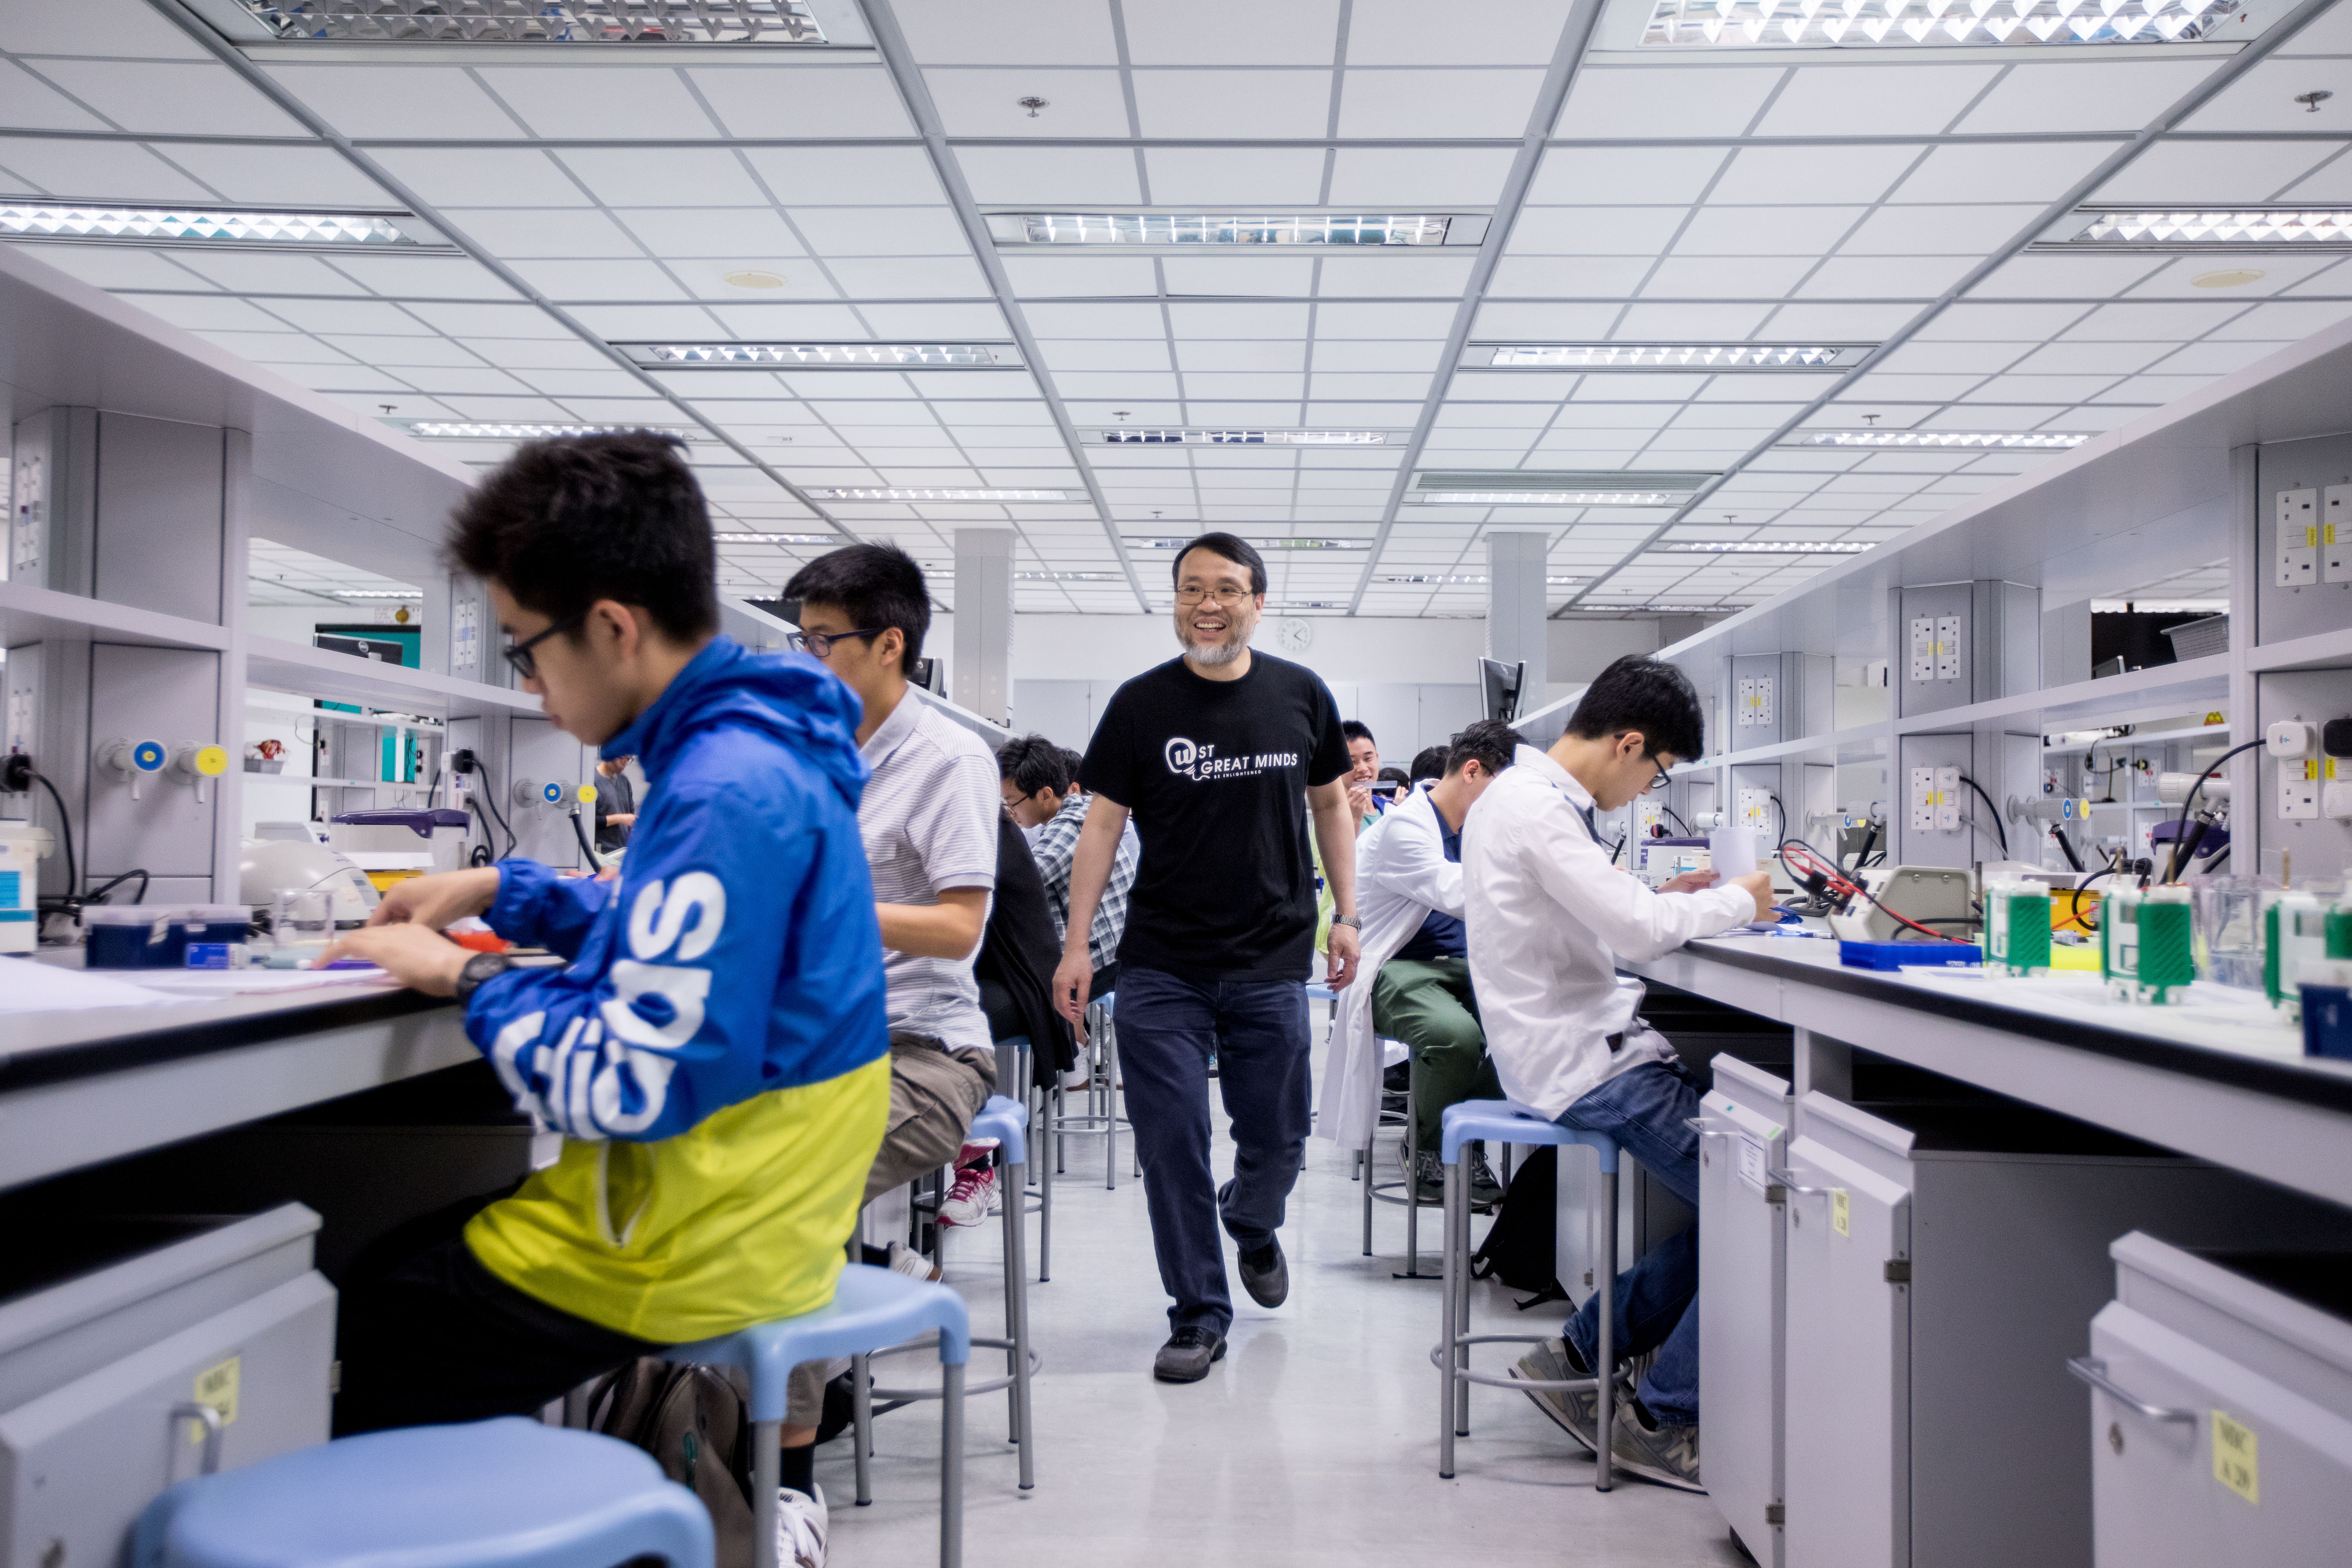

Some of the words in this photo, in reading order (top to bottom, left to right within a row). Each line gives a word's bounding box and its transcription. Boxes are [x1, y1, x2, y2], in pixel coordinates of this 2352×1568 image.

[1201, 757, 1250, 774] GREAT
[1255, 753, 1298, 768] MINDS
[1223, 770, 1262, 778] ENLIGHTENED
